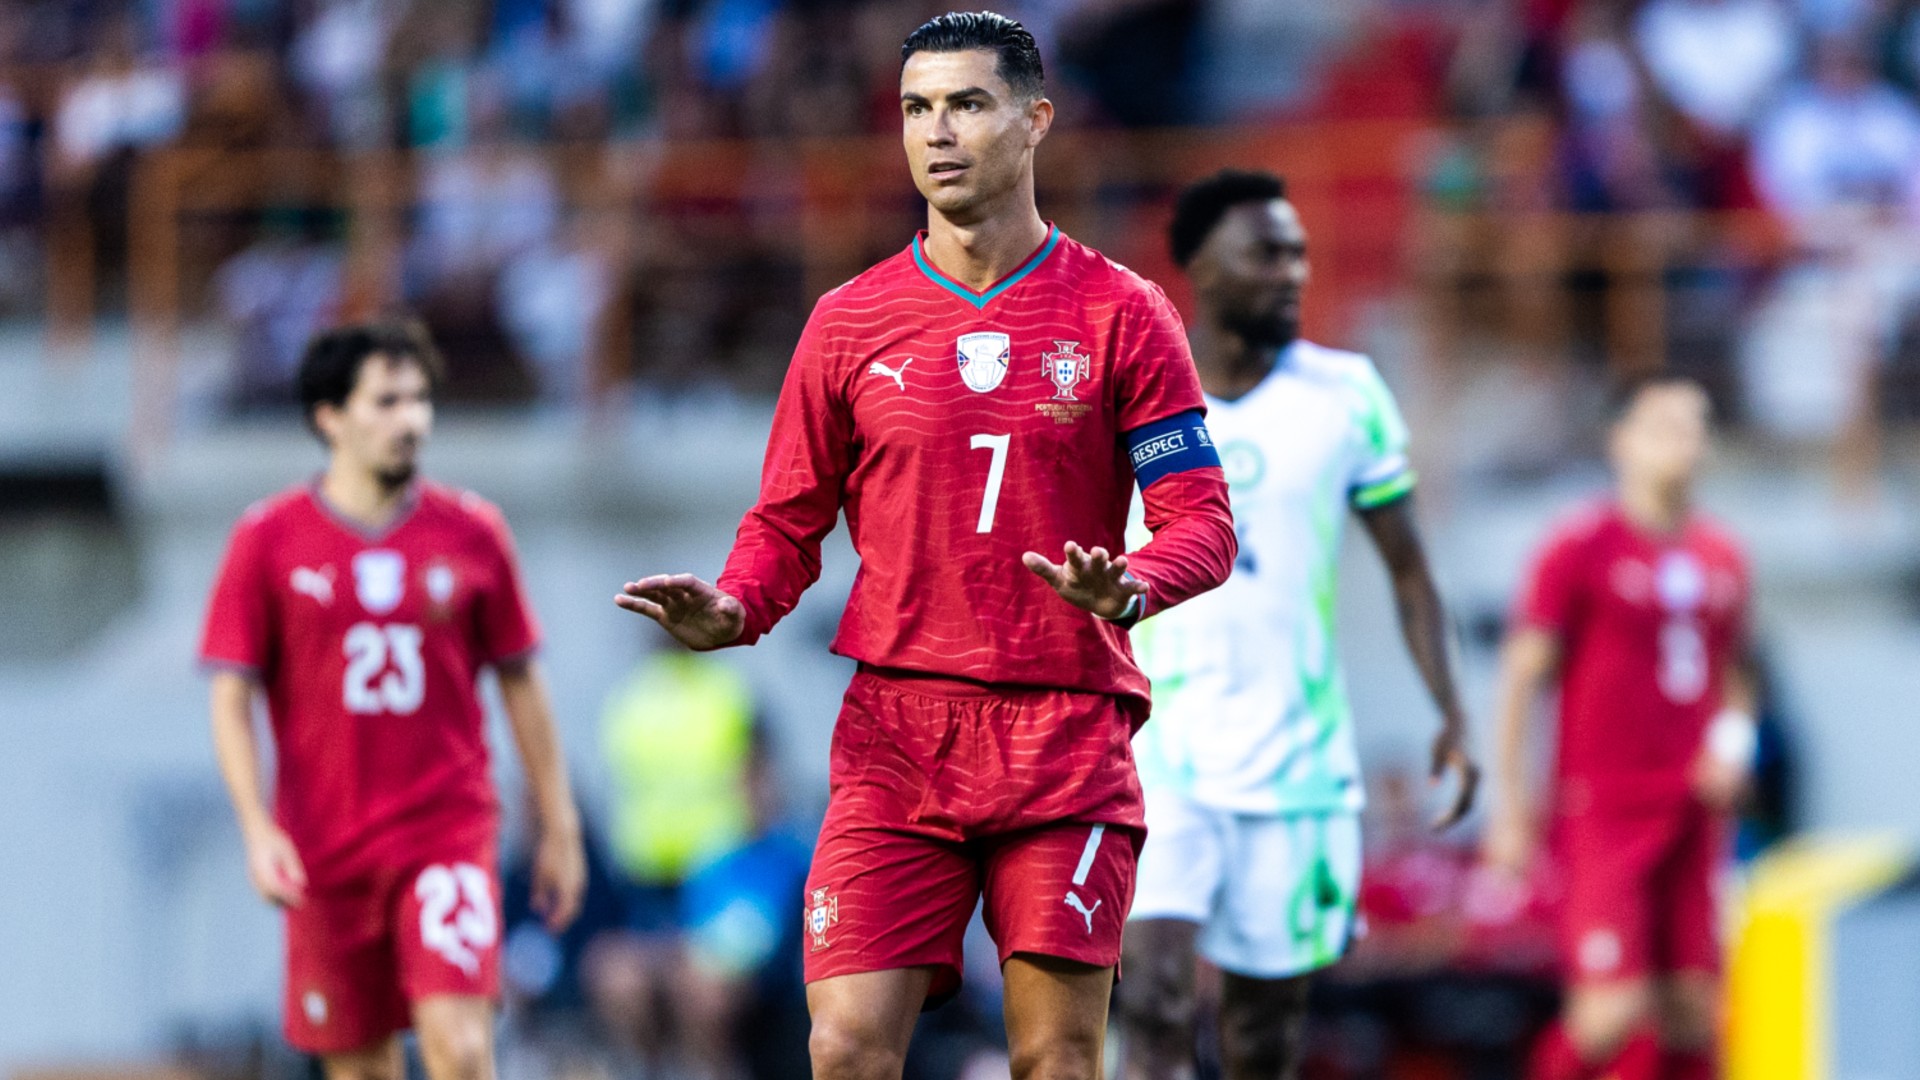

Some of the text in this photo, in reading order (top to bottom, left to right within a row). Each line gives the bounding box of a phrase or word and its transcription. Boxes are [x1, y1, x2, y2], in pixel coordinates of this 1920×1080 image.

[970, 433, 1011, 533] 7
[1133, 434, 1184, 463] RESPECT
[343, 621, 427, 716] 23
[415, 861, 498, 950] 23
